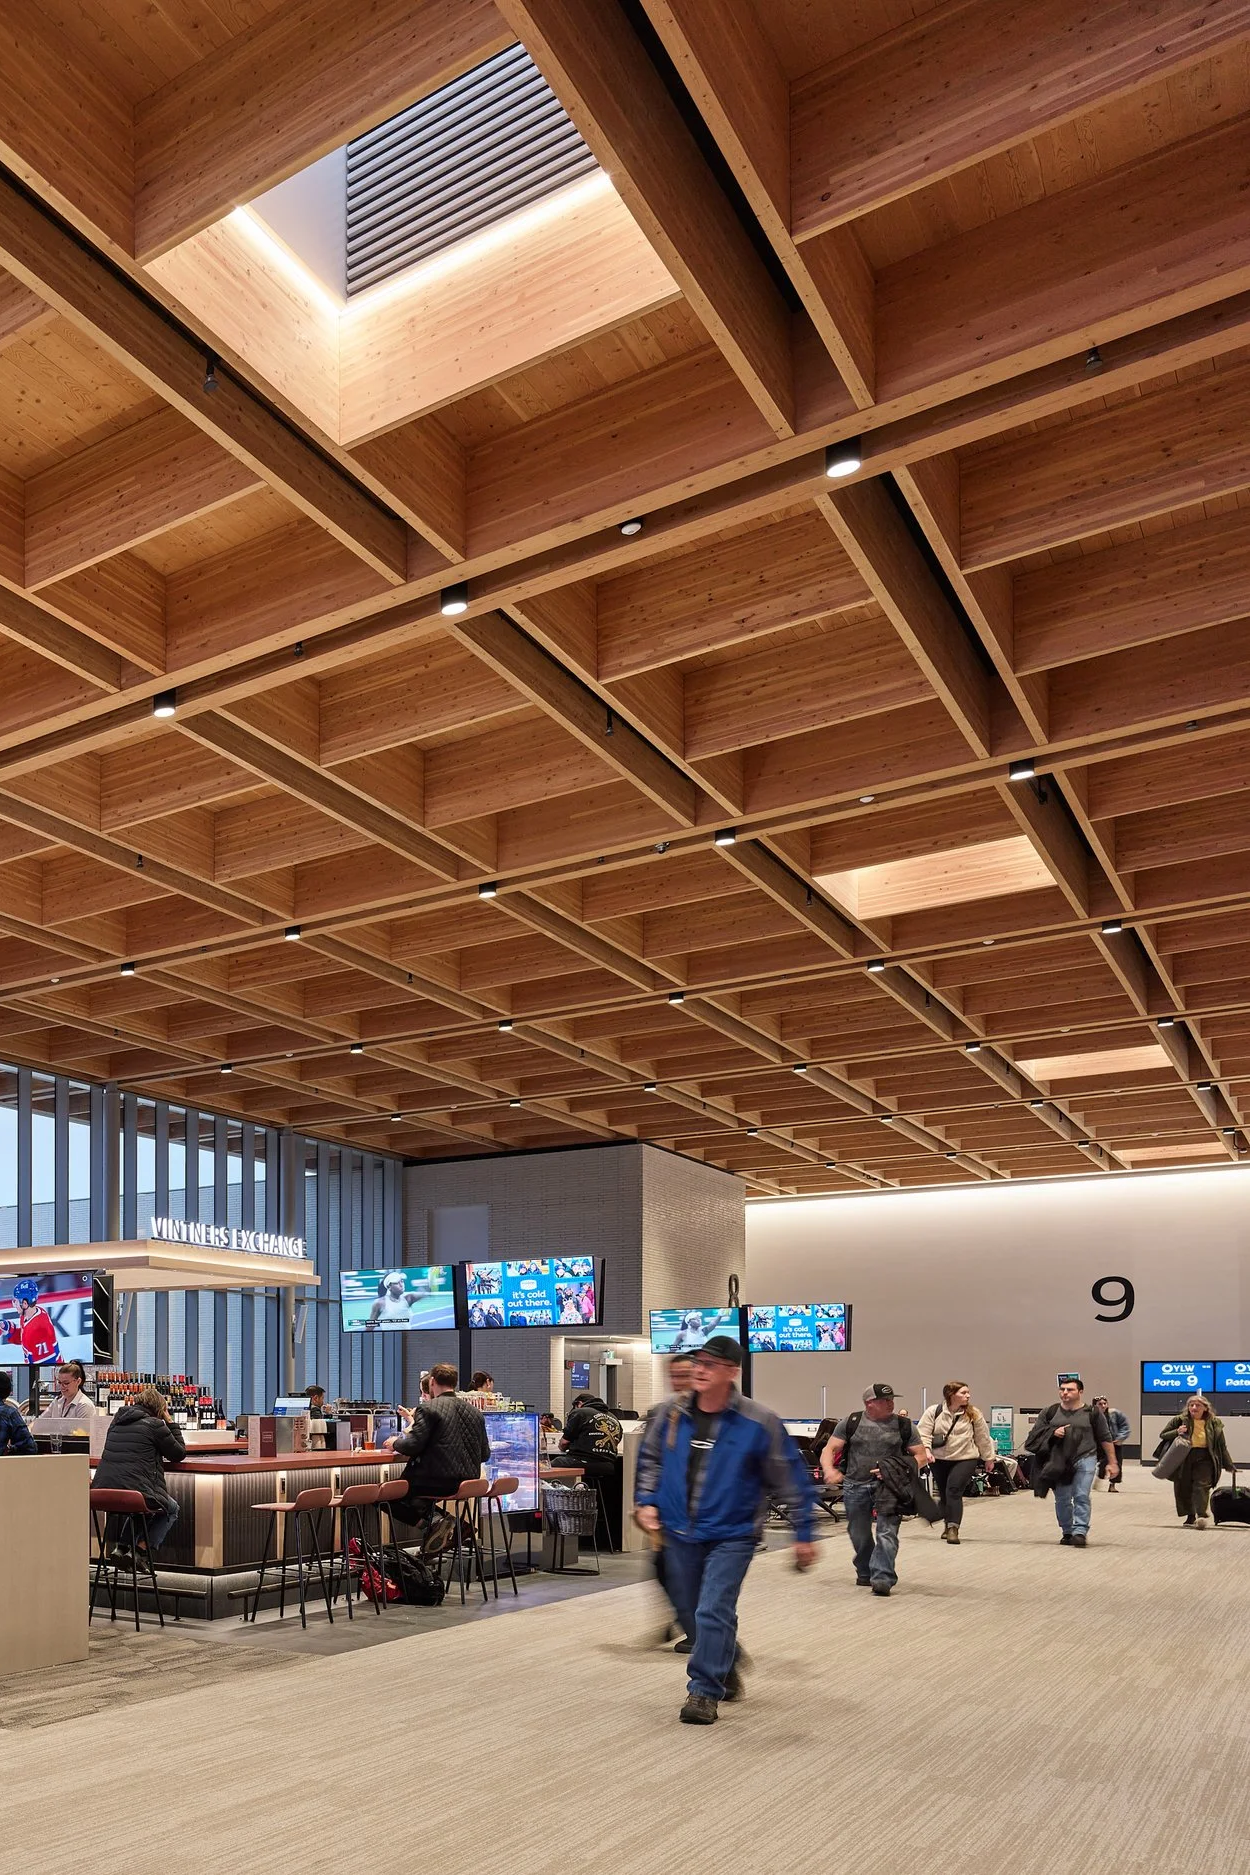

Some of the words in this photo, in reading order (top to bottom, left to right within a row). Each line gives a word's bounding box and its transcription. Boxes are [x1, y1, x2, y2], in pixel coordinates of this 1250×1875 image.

[151, 1216, 230, 1248] VINTNERS
[232, 1228, 307, 1258] EXCHANGE
[512, 1291, 525, 1299] it's
[527, 1290, 546, 1298] cold
[1092, 1276, 1135, 1322] 9
[525, 1299, 552, 1307] there.
[36, 1342, 49, 1355] 71
[1186, 1375, 1198, 1386] 9
